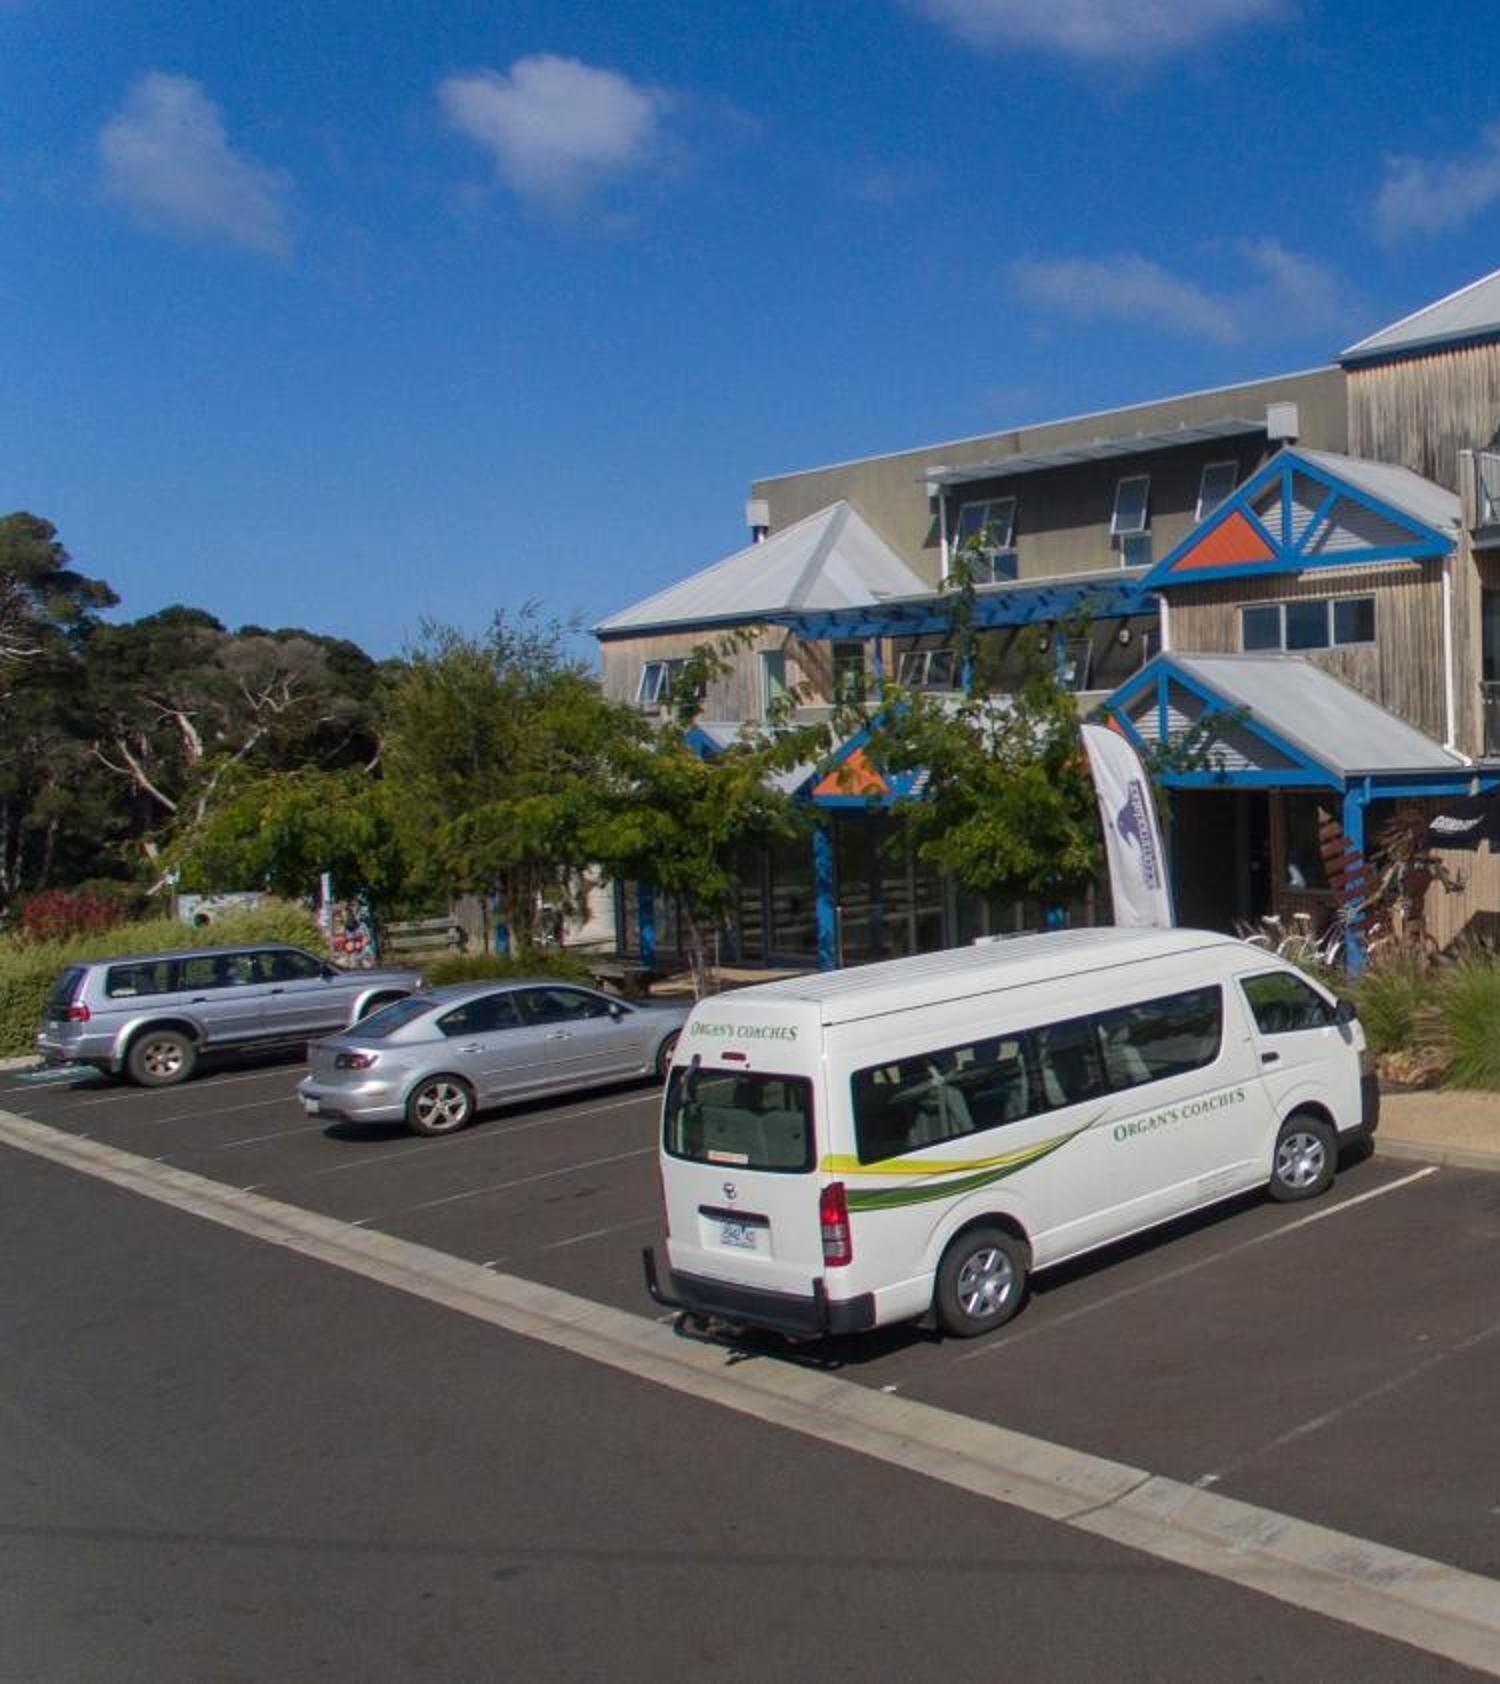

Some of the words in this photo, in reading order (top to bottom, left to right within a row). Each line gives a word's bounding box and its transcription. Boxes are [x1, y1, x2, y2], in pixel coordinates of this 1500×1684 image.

[737, 1025, 798, 1040] COACHES
[1113, 1110, 1179, 1142] ORGAN'S
[1182, 1087, 1246, 1118] COACHES
